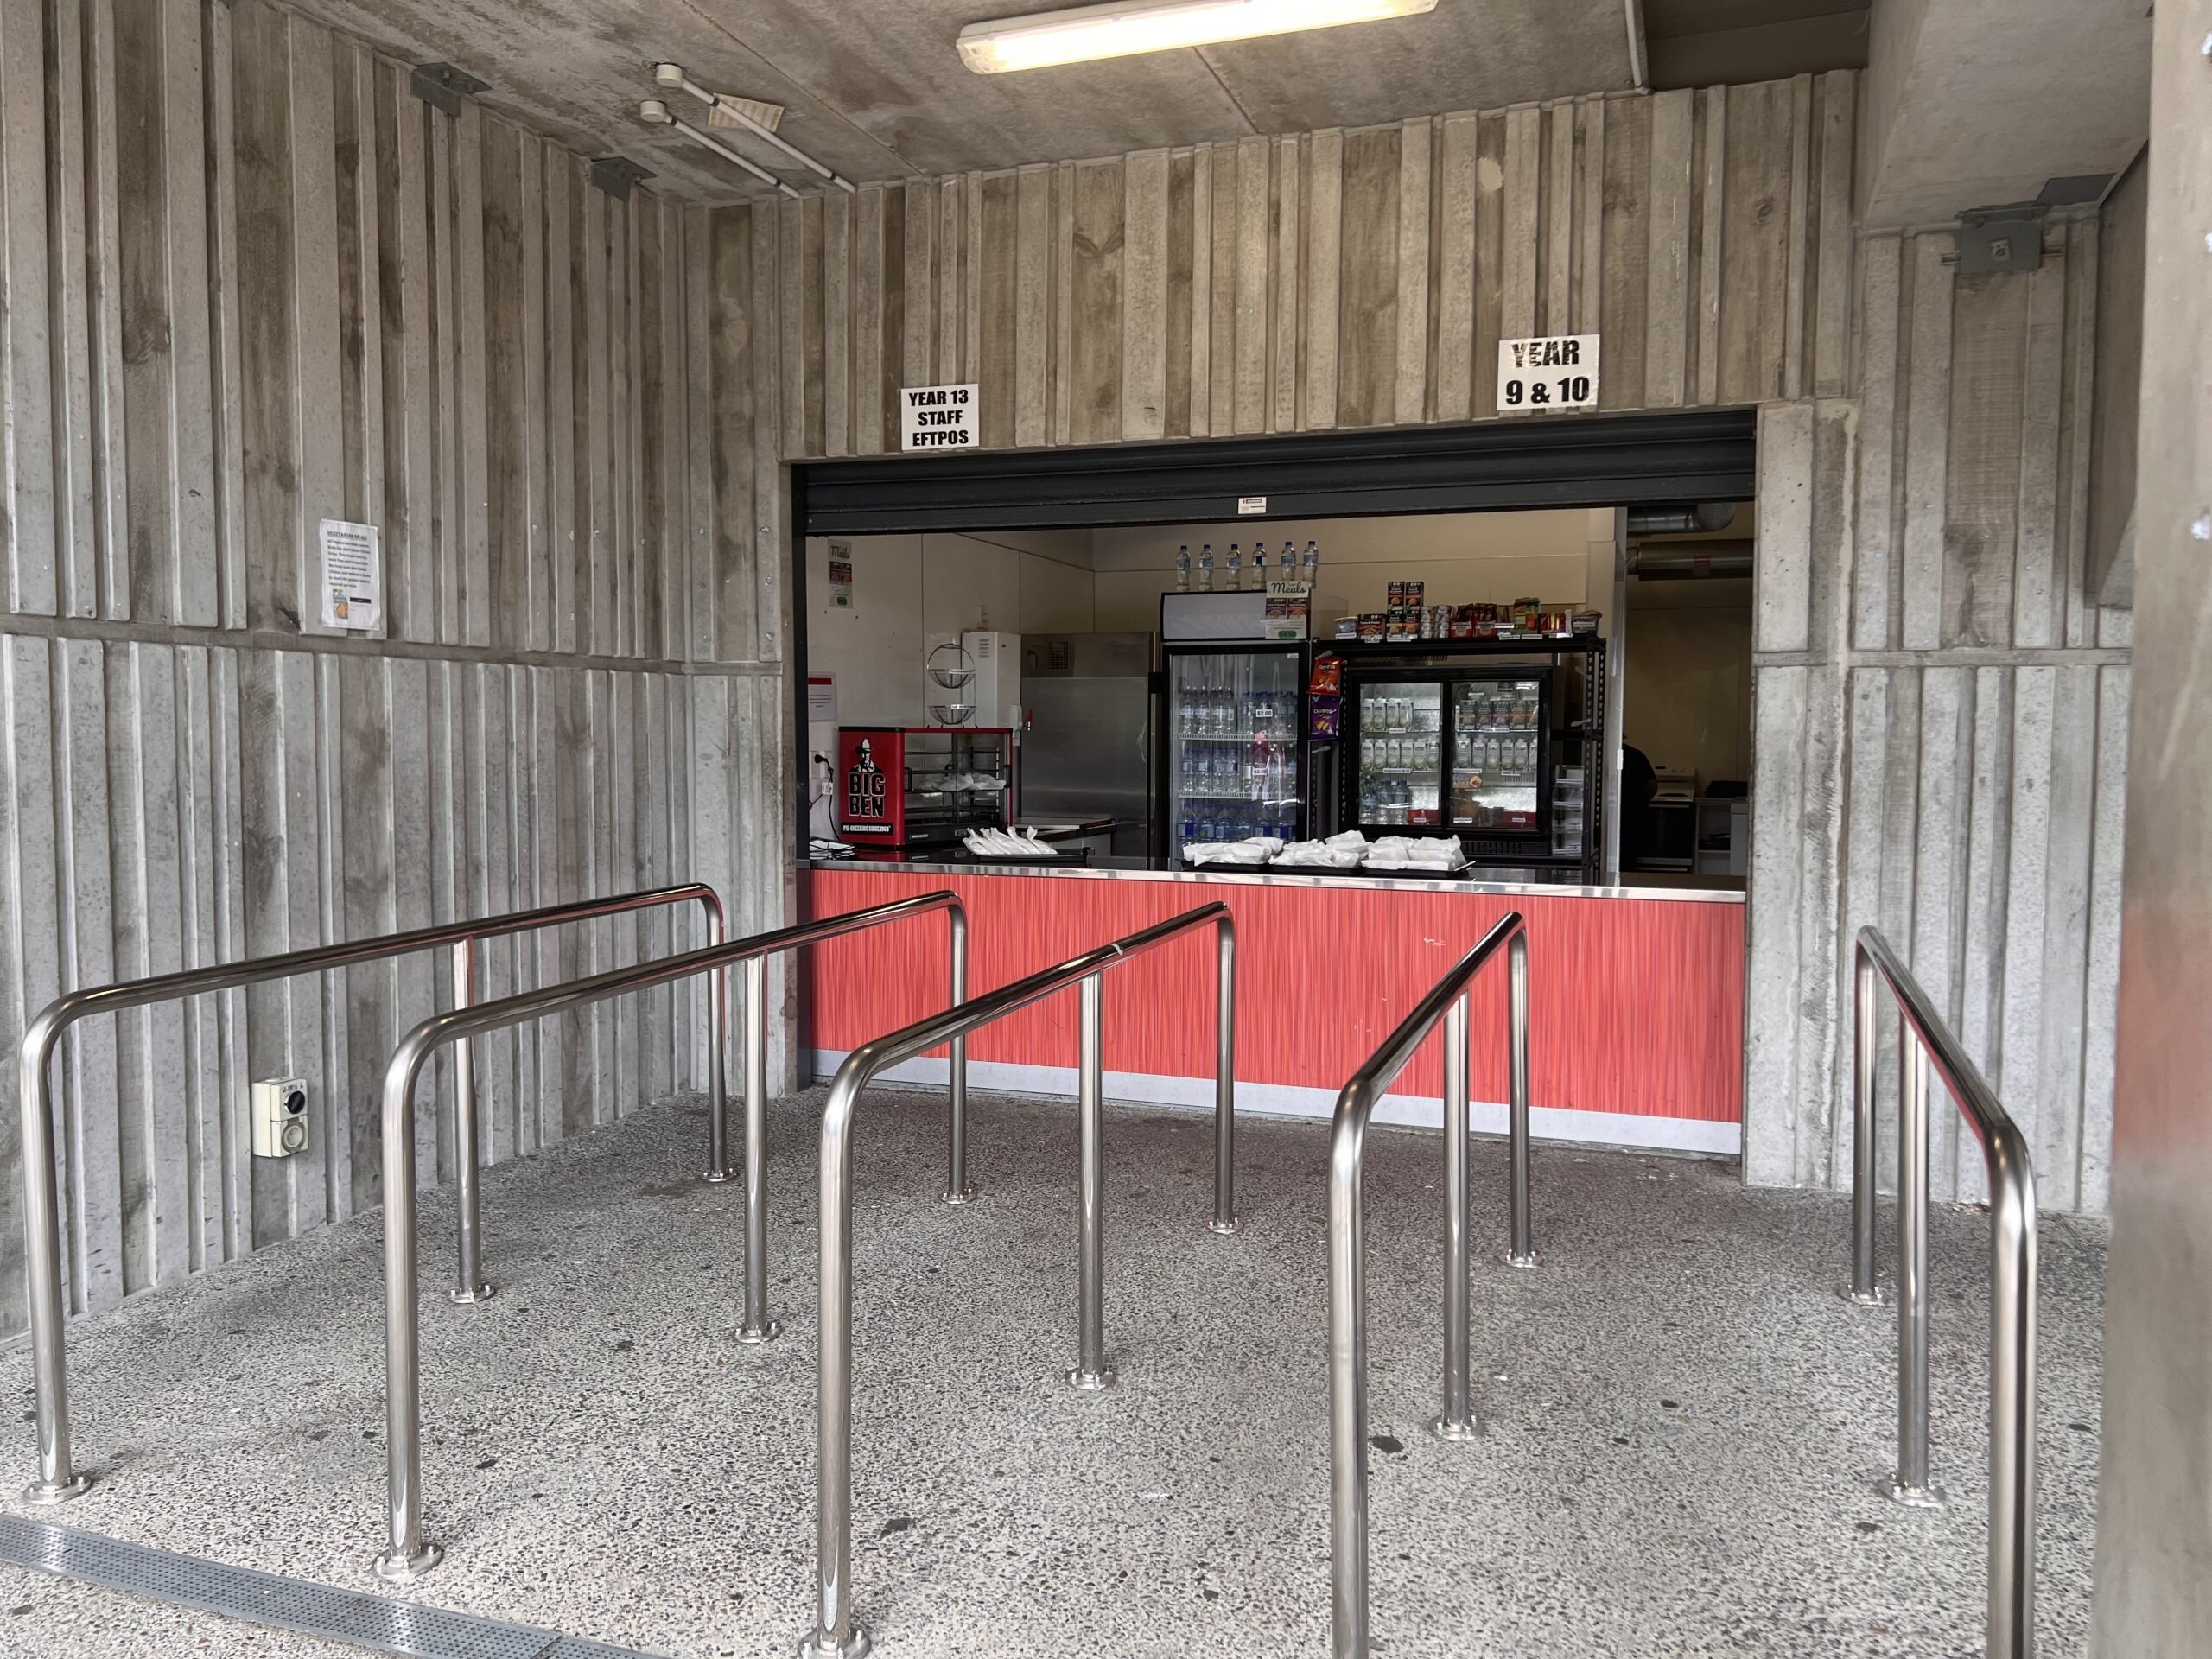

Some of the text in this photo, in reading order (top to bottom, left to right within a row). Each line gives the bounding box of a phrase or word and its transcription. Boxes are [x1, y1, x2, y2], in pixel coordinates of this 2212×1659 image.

[1511, 340, 1580, 367] YEAR
[909, 389, 969, 406] YEAR 13
[1506, 376, 1590, 405] 9 & 10
[918, 410, 963, 426] STAFF
[912, 430, 969, 447] EFTPOS
[1271, 581, 1307, 594] Meals
[849, 772, 885, 796] BIG
[849, 795, 885, 818] BEN
